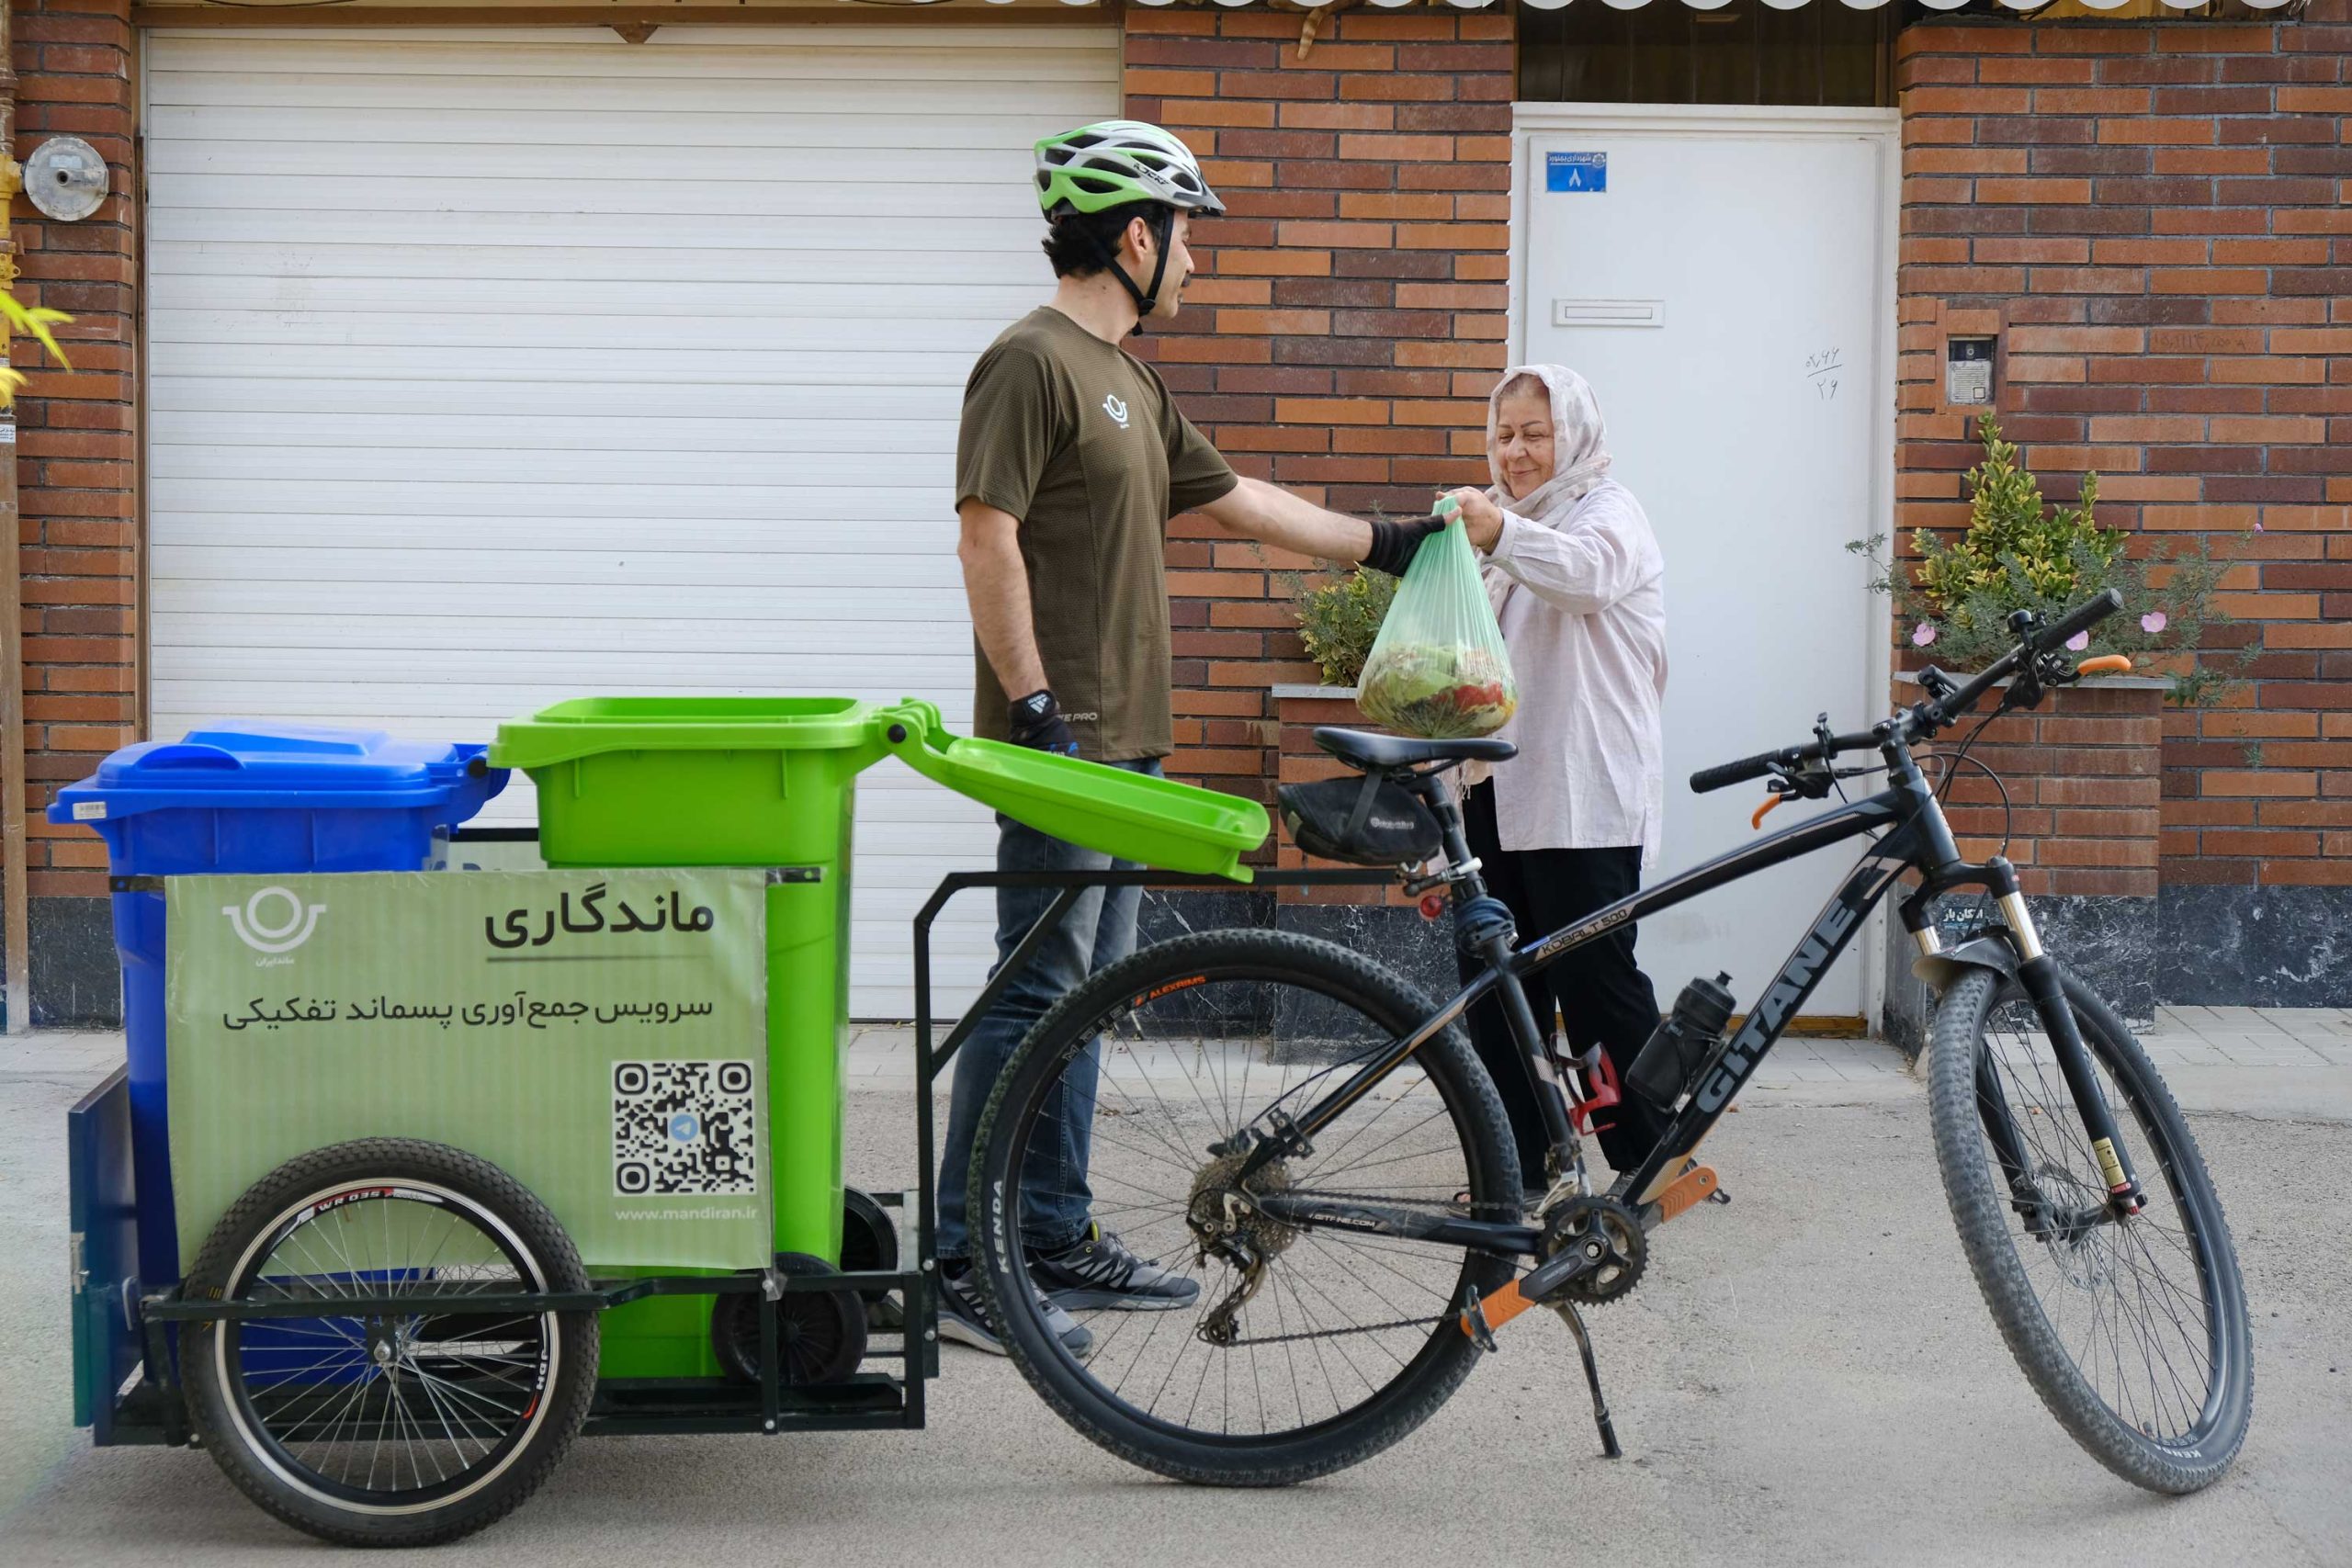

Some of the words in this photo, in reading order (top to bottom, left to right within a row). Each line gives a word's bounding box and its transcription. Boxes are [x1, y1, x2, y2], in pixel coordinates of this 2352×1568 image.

[1568, 167, 1581, 187] ۸
[1072, 712, 1098, 722] PRO
[484, 882, 714, 949] ماندگاری
[1542, 921, 1599, 954] KOBALT
[1601, 908, 1628, 927] 500
[1149, 975, 1206, 999] ALEXRIMS
[223, 998, 336, 1030] تفکیکی
[345, 996, 452, 1029] پسماند
[594, 999, 712, 1024] سرویس
[1696, 897, 1857, 1113] GITANE
[616, 1205, 757, 1221] www.mandiran.ir
[992, 1180, 1010, 1273] KENDA
